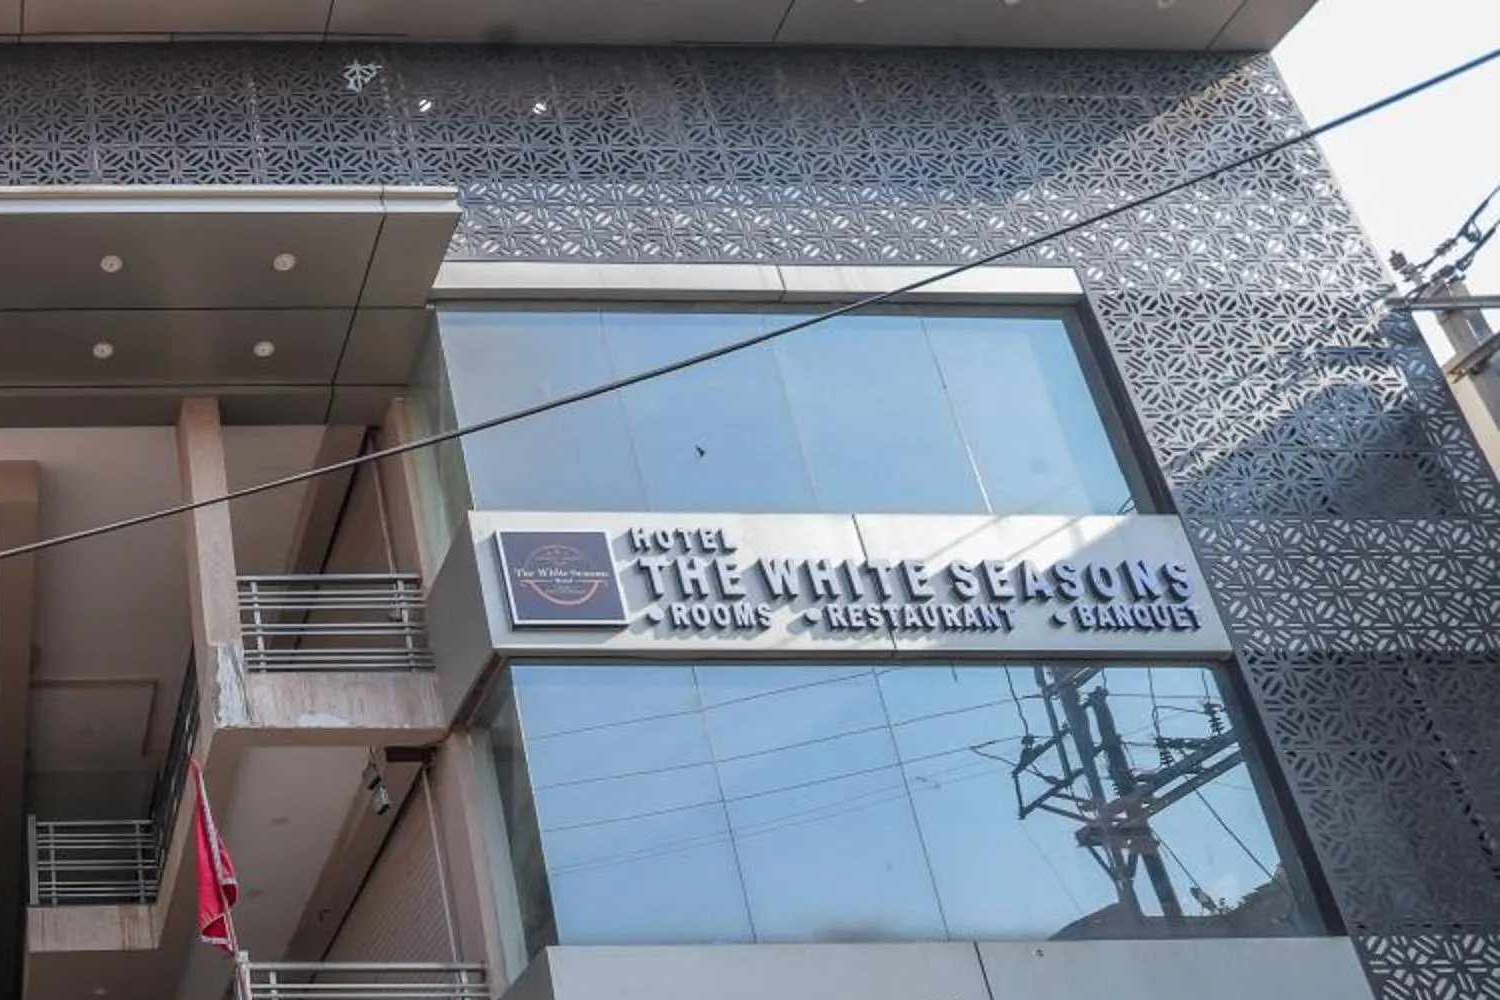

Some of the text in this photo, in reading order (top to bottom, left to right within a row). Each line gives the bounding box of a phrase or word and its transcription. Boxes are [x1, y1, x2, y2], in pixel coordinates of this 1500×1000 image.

[630, 527, 737, 551] HOTEL
[637, 557, 1195, 599] THE WHITE SEASONS
[670, 602, 1201, 631] ROOMS RESTAURANT BANQUET
